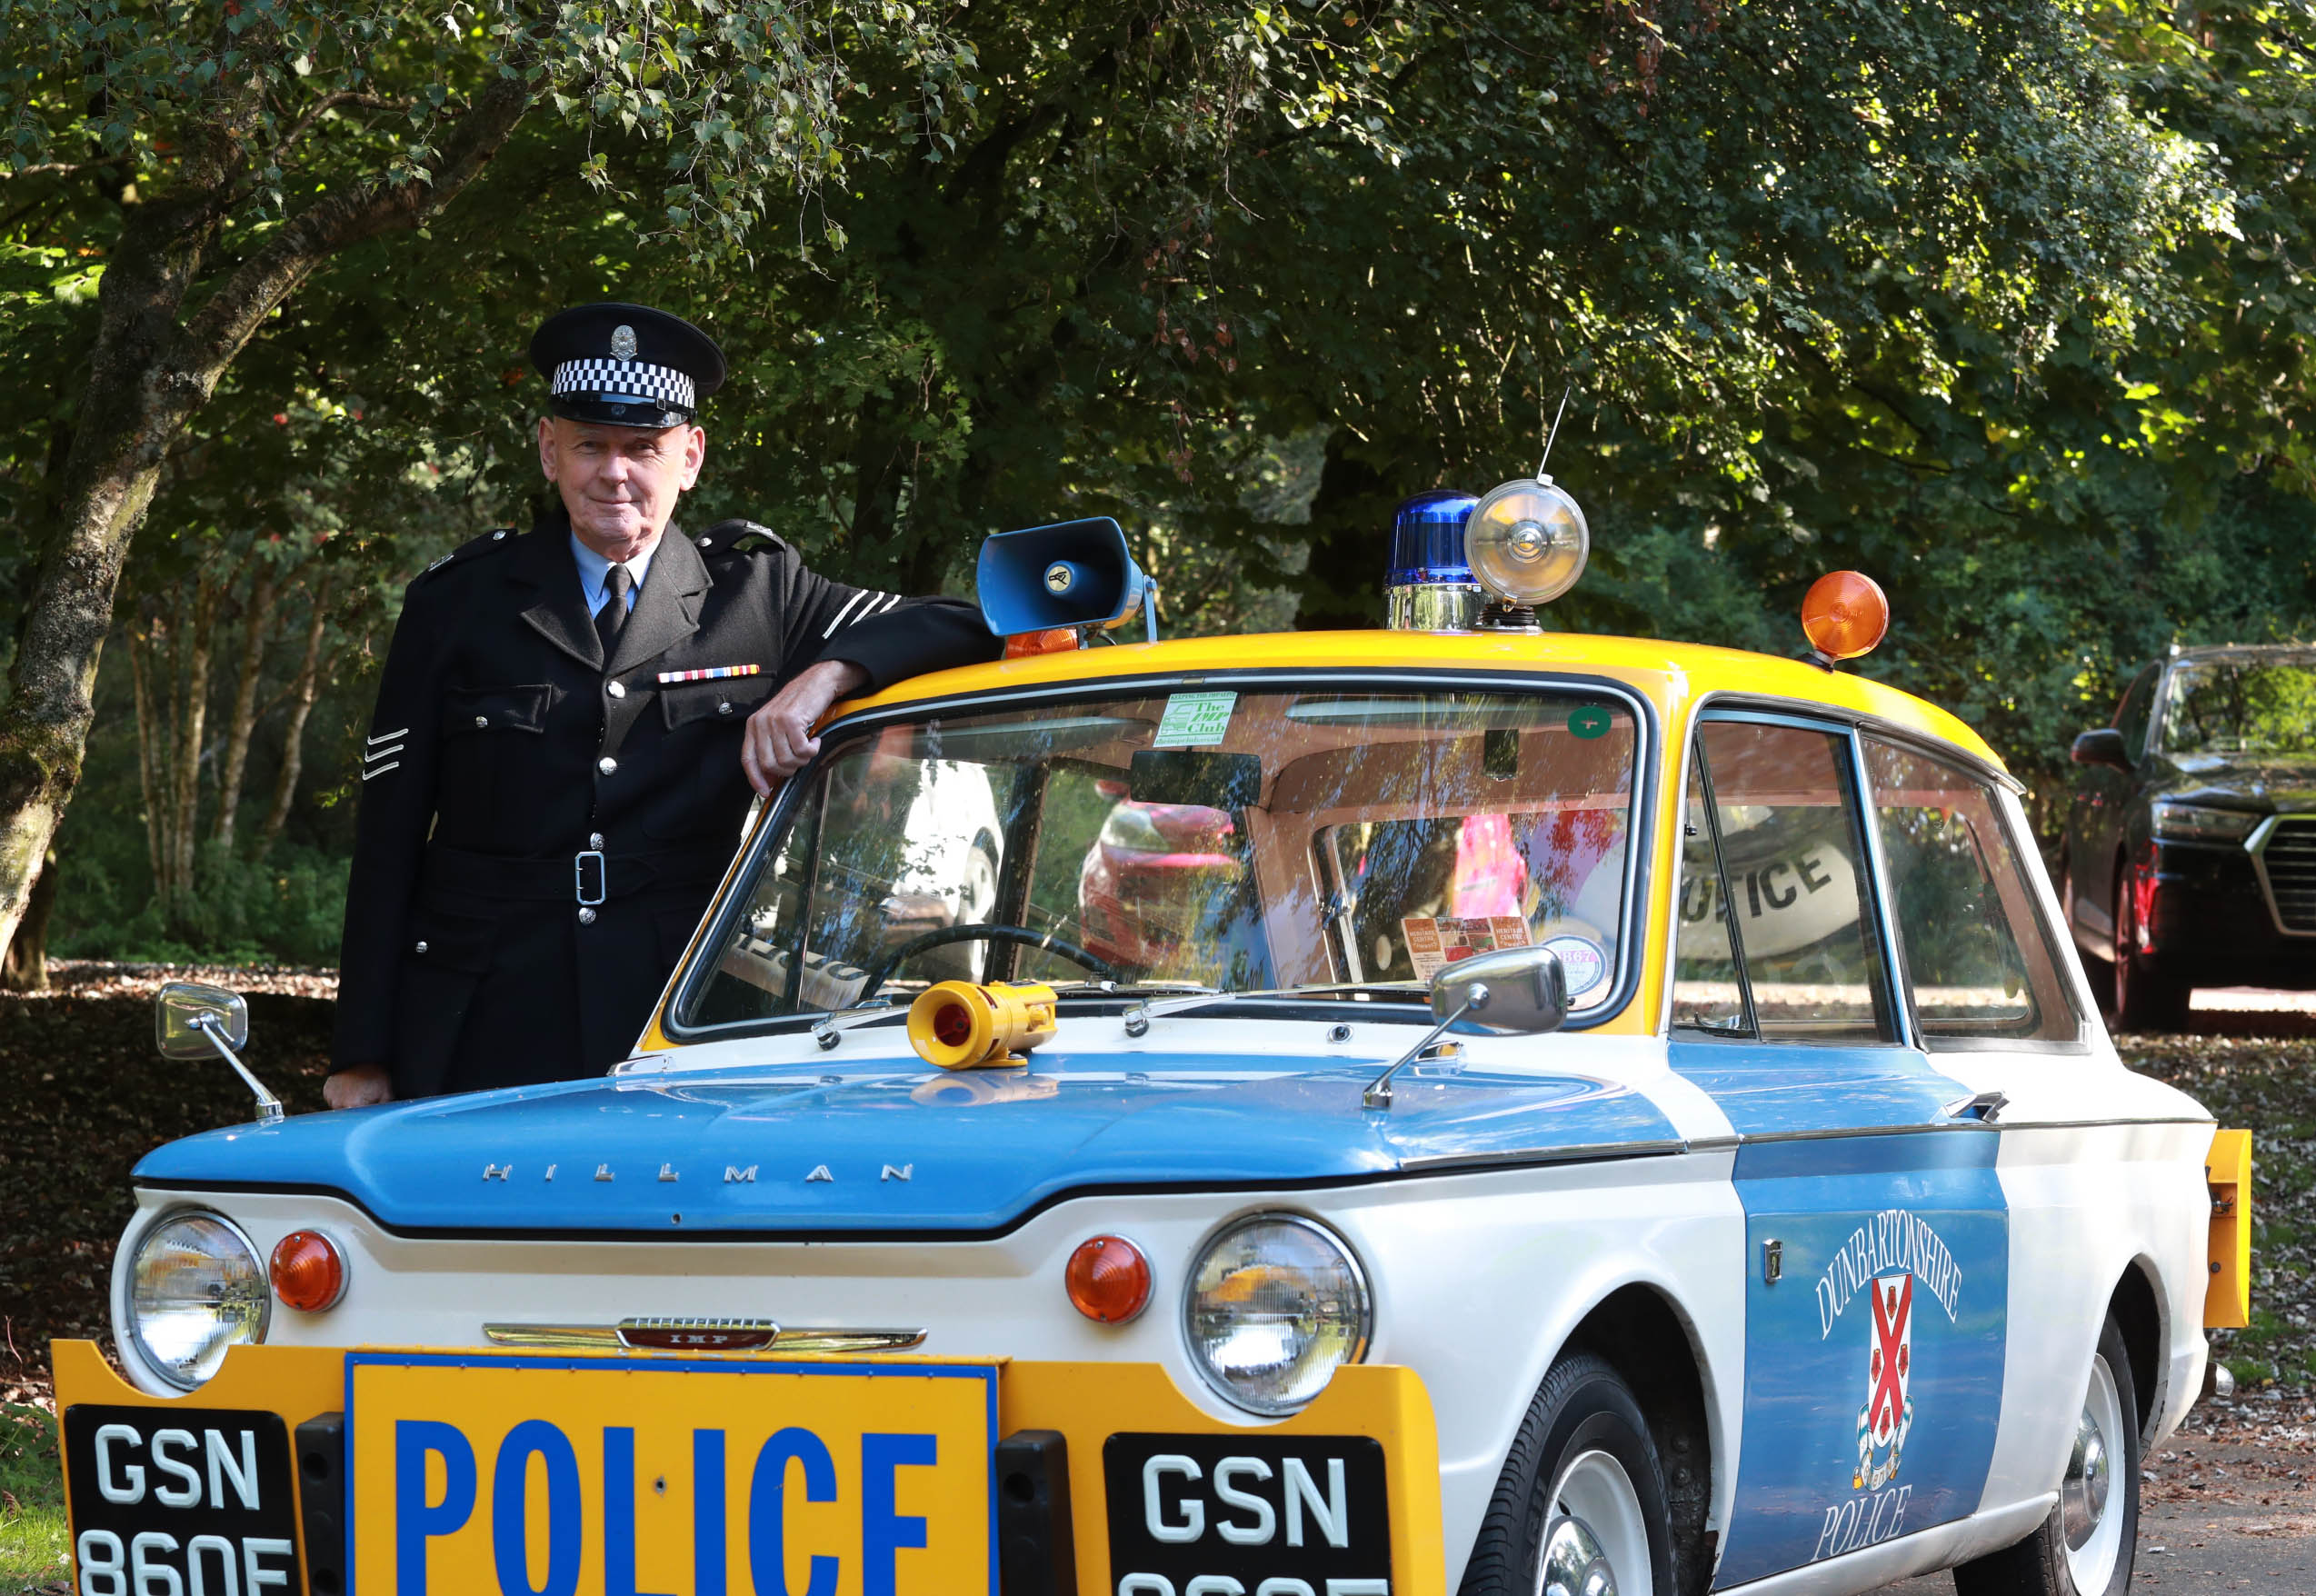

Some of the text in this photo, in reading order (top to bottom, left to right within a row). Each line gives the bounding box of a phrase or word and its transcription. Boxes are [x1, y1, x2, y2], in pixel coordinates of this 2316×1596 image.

[1187, 723, 1225, 733] Club
[1195, 702, 1225, 712] The
[483, 1162, 913, 1182] HILLMAN
[1815, 1209, 1962, 1341] DUNBARTONSHIRE
[669, 1334, 728, 1344] IMP
[95, 1423, 260, 1511] GSN
[1143, 1454, 1349, 1548] GSN
[395, 1419, 937, 1596] POLICE
[1810, 1484, 1912, 1562] POLICE
